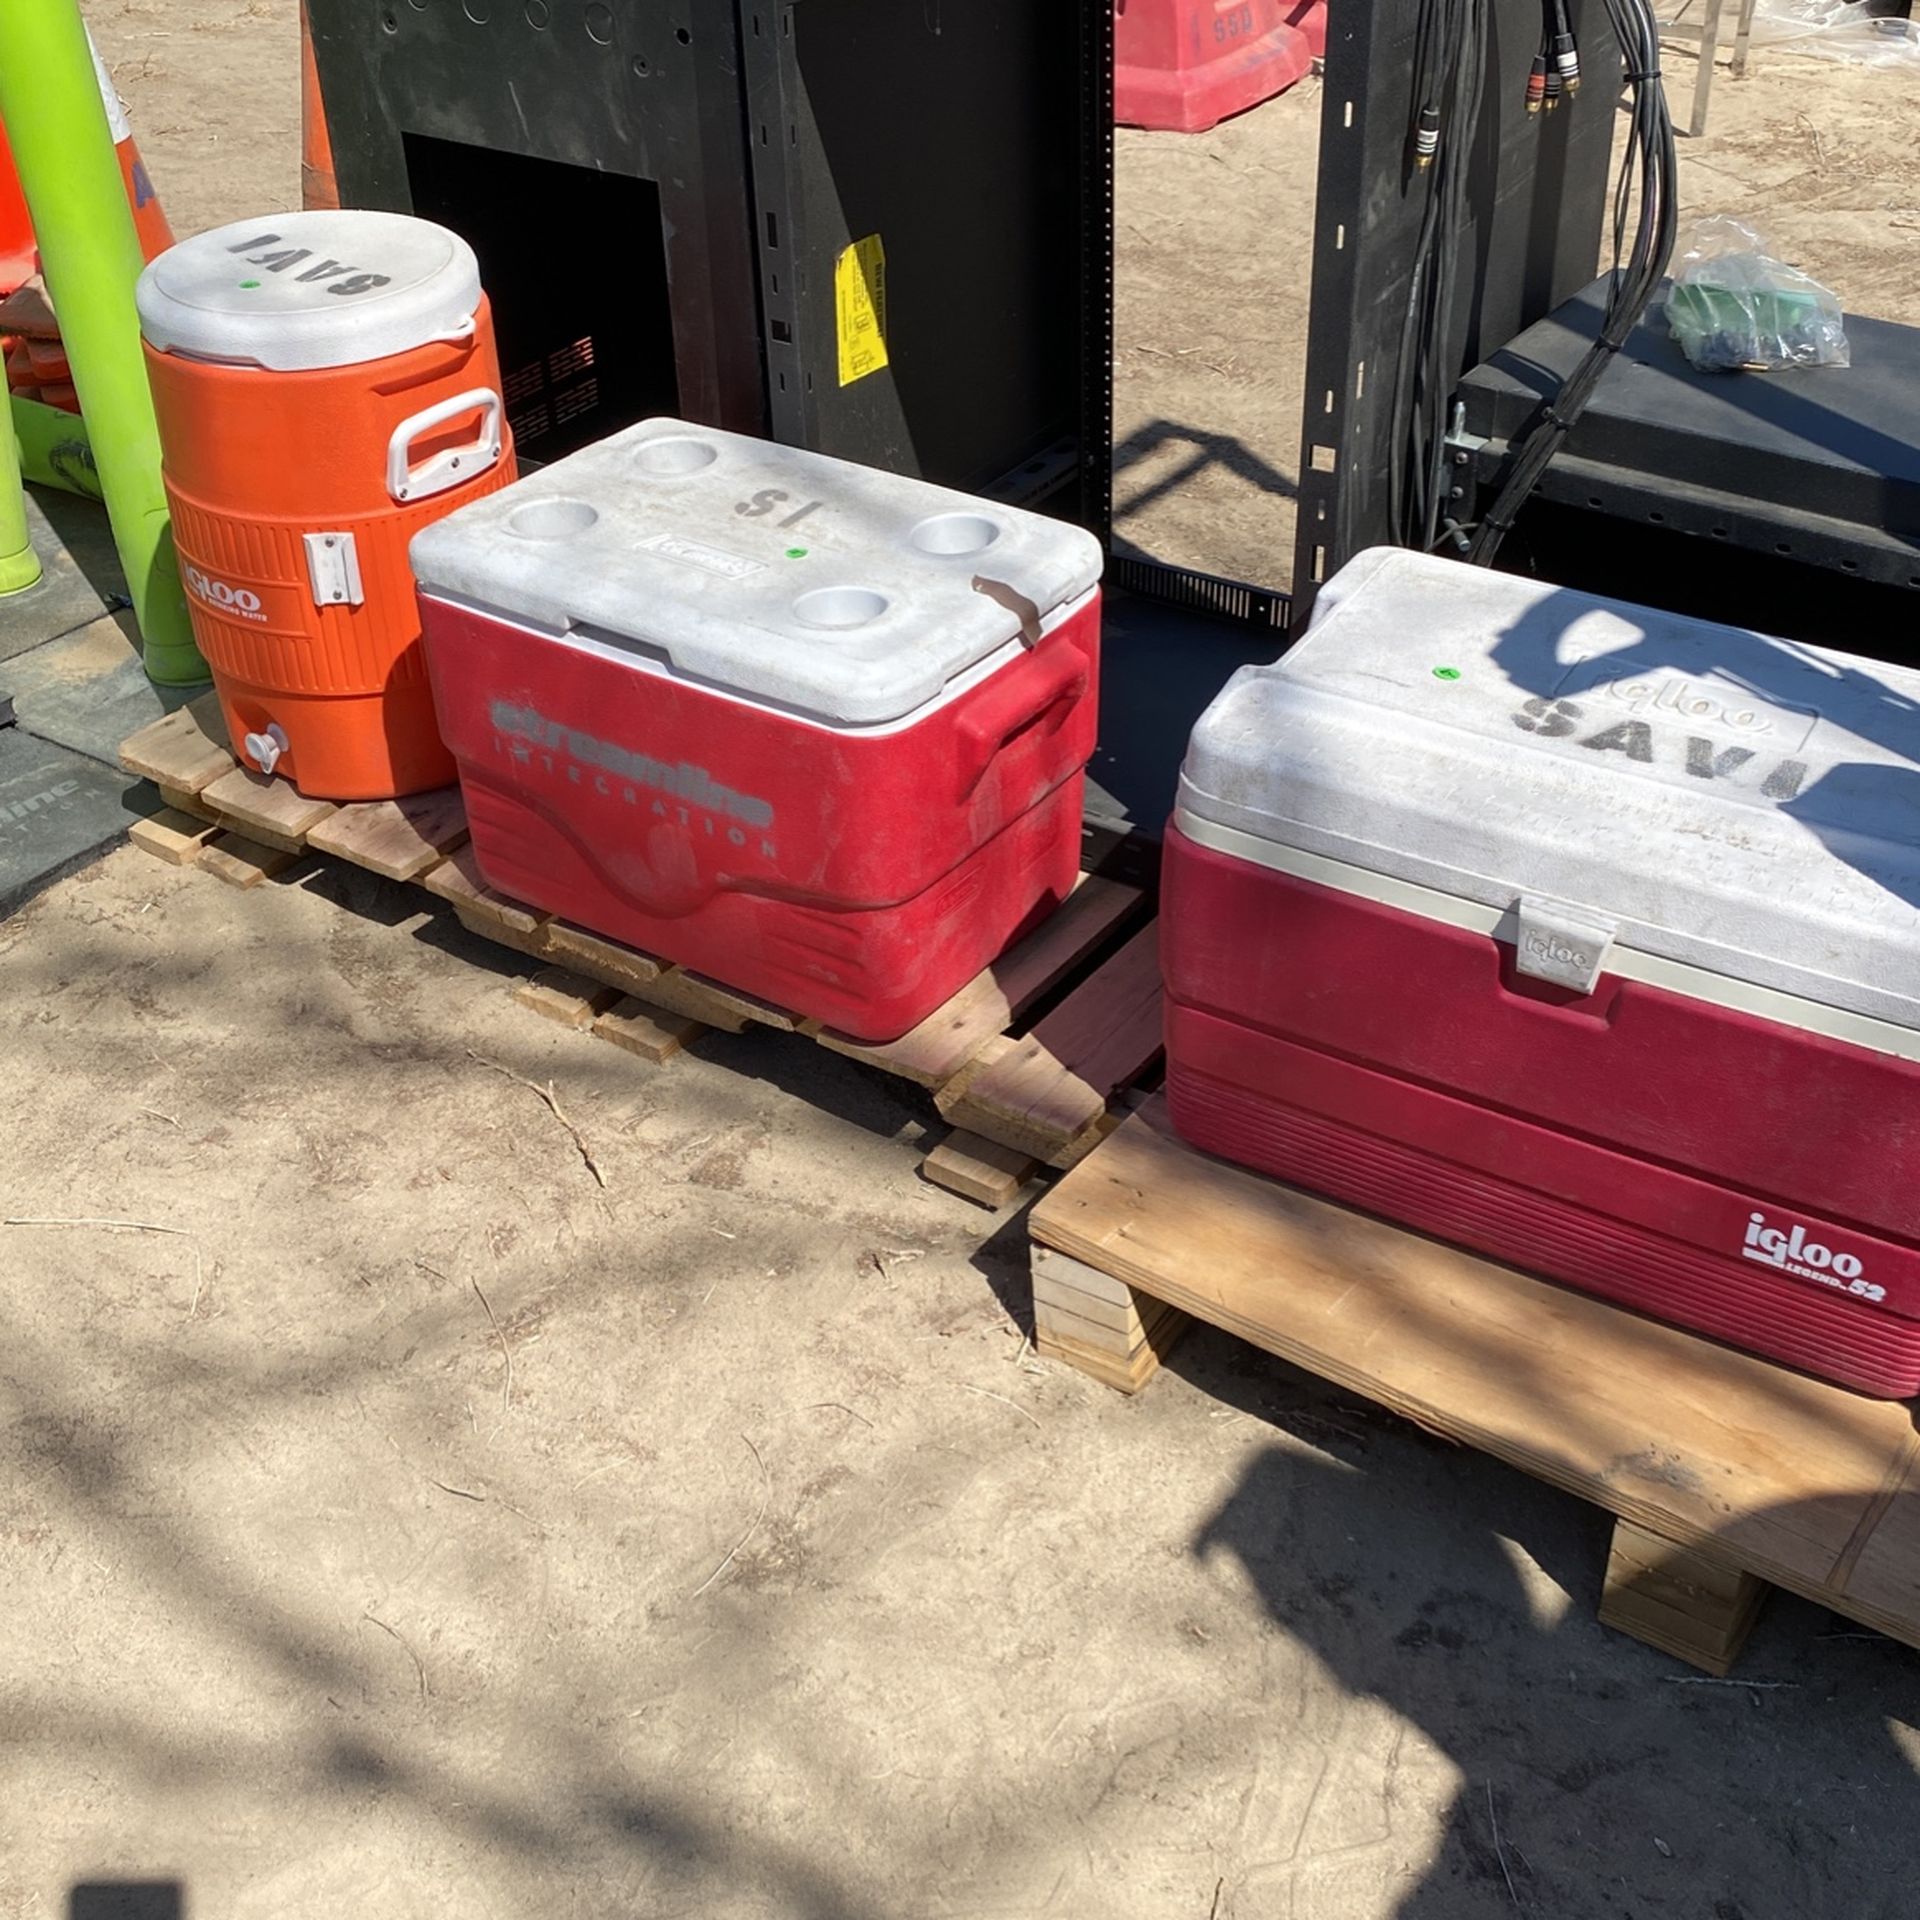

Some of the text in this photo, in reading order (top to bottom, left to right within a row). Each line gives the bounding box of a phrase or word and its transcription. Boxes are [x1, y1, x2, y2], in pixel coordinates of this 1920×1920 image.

[227, 233, 391, 296] SAVI
[1511, 698, 1808, 800] SAVI
[1525, 929, 1590, 970] igloo
[1742, 1212, 1864, 1278] igloo
[1847, 1278, 1887, 1303] 52
